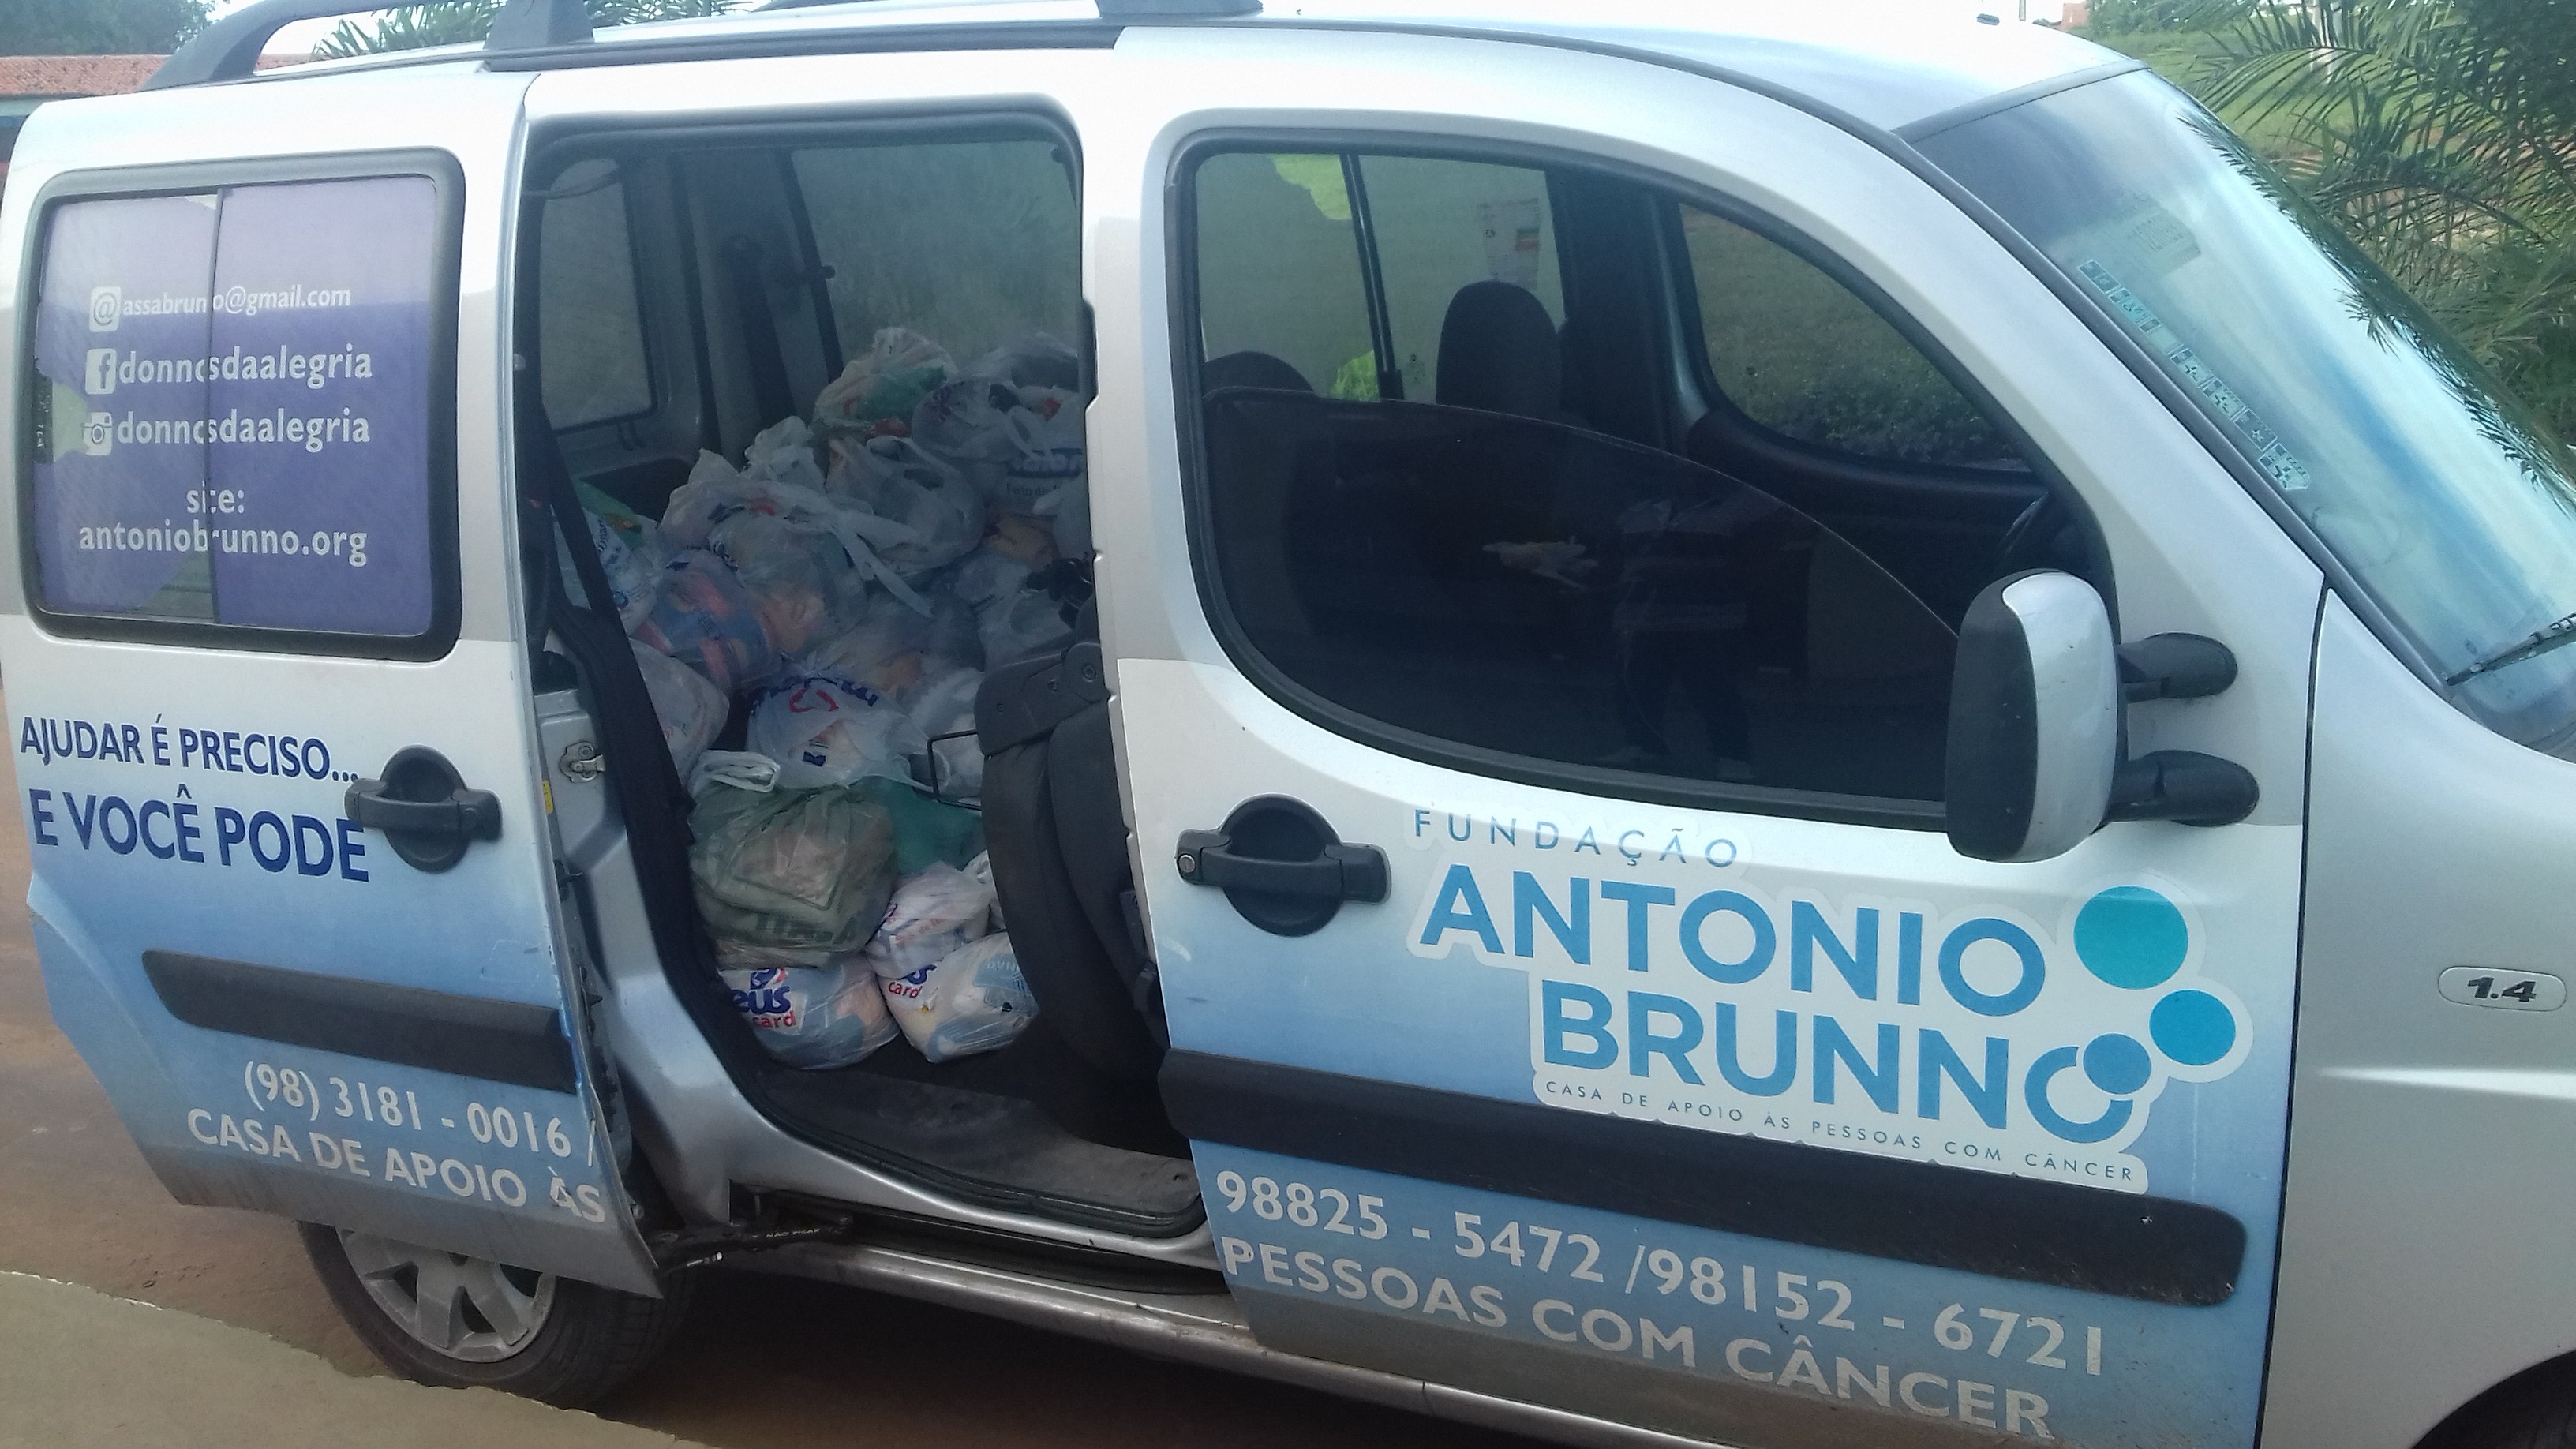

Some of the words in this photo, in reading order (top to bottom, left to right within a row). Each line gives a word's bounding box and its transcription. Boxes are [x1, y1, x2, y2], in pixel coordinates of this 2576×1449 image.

[21, 715, 145, 766] AJUDAR
[152, 713, 172, 766] É
[178, 728, 358, 783] PRECISO...
[29, 788, 59, 847] E
[62, 783, 205, 864] VOCÊ
[215, 807, 370, 882] PODE
[1414, 808, 1739, 868] FUNDAÇÃO
[889, 981, 923, 999] card
[1420, 863, 2046, 1018] ANTONIO
[2467, 976, 2537, 1002] 1.4
[244, 1060, 320, 1121] (98)
[329, 1076, 422, 1131] 3181
[440, 1115, 456, 1129] -
[466, 1102, 572, 1158] 0016
[1541, 977, 2140, 1145] BRUNNO
[187, 1107, 300, 1165] CASA
[309, 1136, 371, 1179] DE
[384, 1148, 527, 1208] APOIO
[546, 1165, 606, 1223] ÀS
[1545, 1080, 1603, 1102] CASA
[1622, 1091, 1648, 1107] DE
[1667, 1099, 1743, 1121] APOIO
[1764, 1110, 1791, 1129] ÀS
[1812, 1121, 1921, 1150] PESSOAS
[1944, 1140, 2001, 1162] COM
[2024, 1152, 2132, 1181] CÂNCER
[1215, 1170, 1389, 1242] 98825
[1411, 1227, 1432, 1240] -
[1454, 1211, 1605, 1283] 5472
[1881, 1316, 1905, 1331] -
[1933, 1303, 2102, 1377] 6721
[1221, 1236, 1507, 1329] PESSOAS
[1532, 1297, 1698, 1369] COM
[1725, 1334, 2054, 1441] CÂNCER
